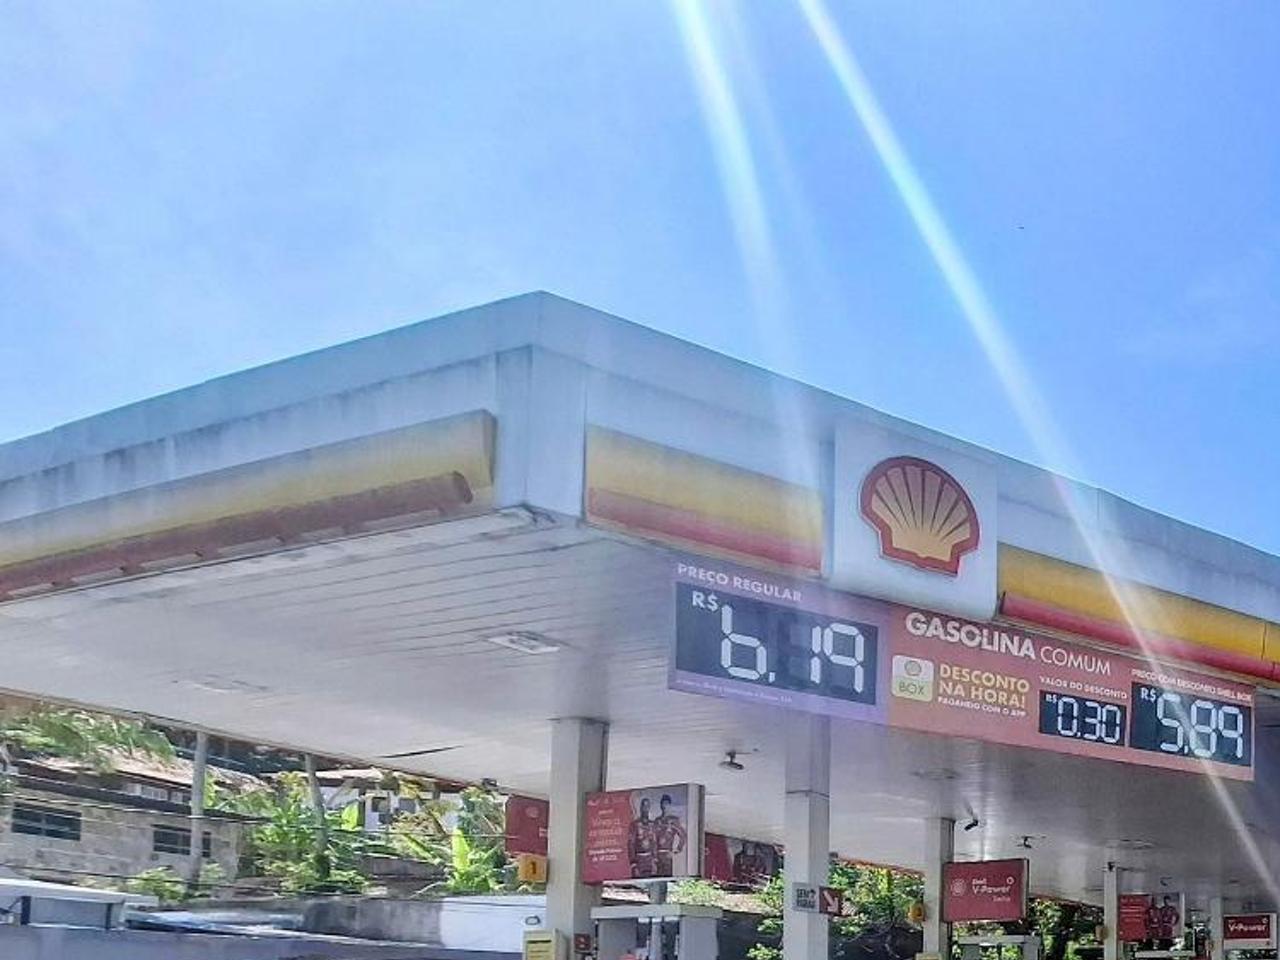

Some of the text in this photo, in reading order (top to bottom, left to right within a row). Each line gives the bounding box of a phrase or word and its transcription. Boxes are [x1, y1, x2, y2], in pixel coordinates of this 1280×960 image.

[733, 576, 801, 601] REGULAR
[692, 590, 719, 612] R$
[905, 612, 1111, 676] GASOLINA COMUM
[899, 681, 925, 696] BOX
[939, 663, 1030, 693] DESCONTO
[939, 680, 1027, 709] NA HORA!
[1069, 681, 1082, 691] DO
[1083, 683, 1128, 699] DESCONTO
[1141, 687, 1156, 702] R$
